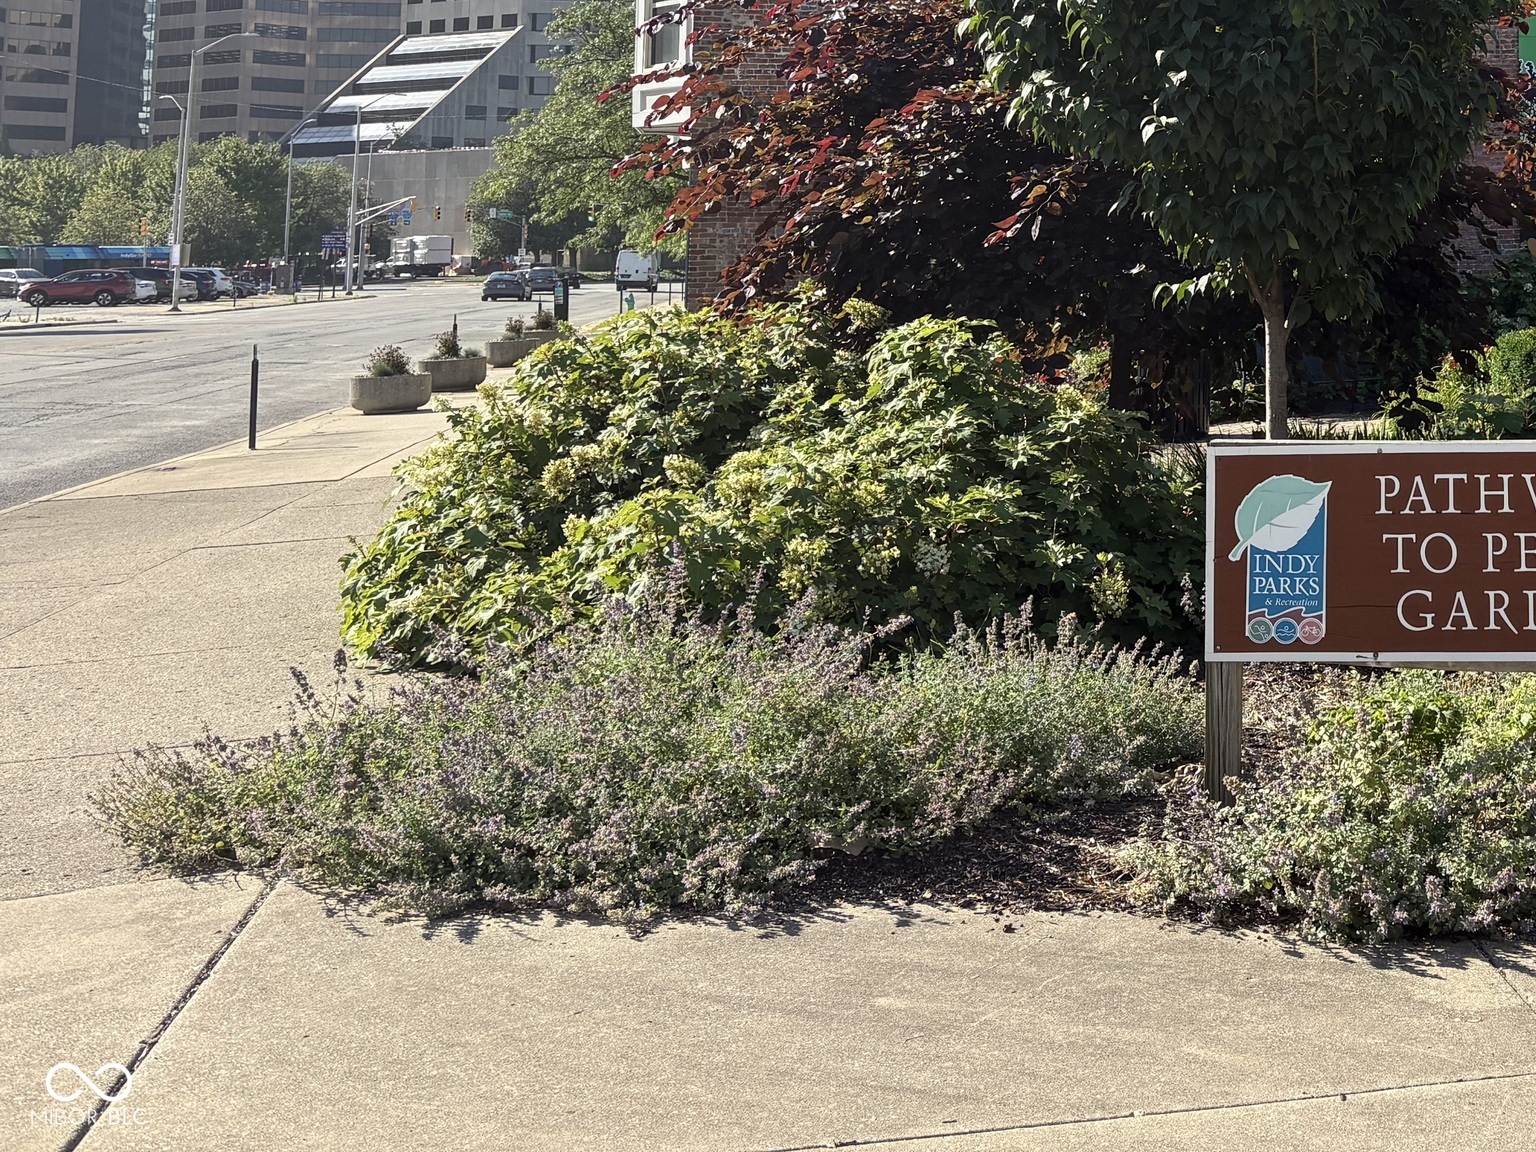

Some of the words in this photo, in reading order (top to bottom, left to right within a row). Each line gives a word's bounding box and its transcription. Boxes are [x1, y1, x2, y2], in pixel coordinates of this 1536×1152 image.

[1382, 532, 1458, 574] TO
[1253, 554, 1320, 574] INDY
[1253, 577, 1320, 596] PARKS
[1265, 598, 1272, 606] &
[1275, 598, 1318, 606] Recreation
